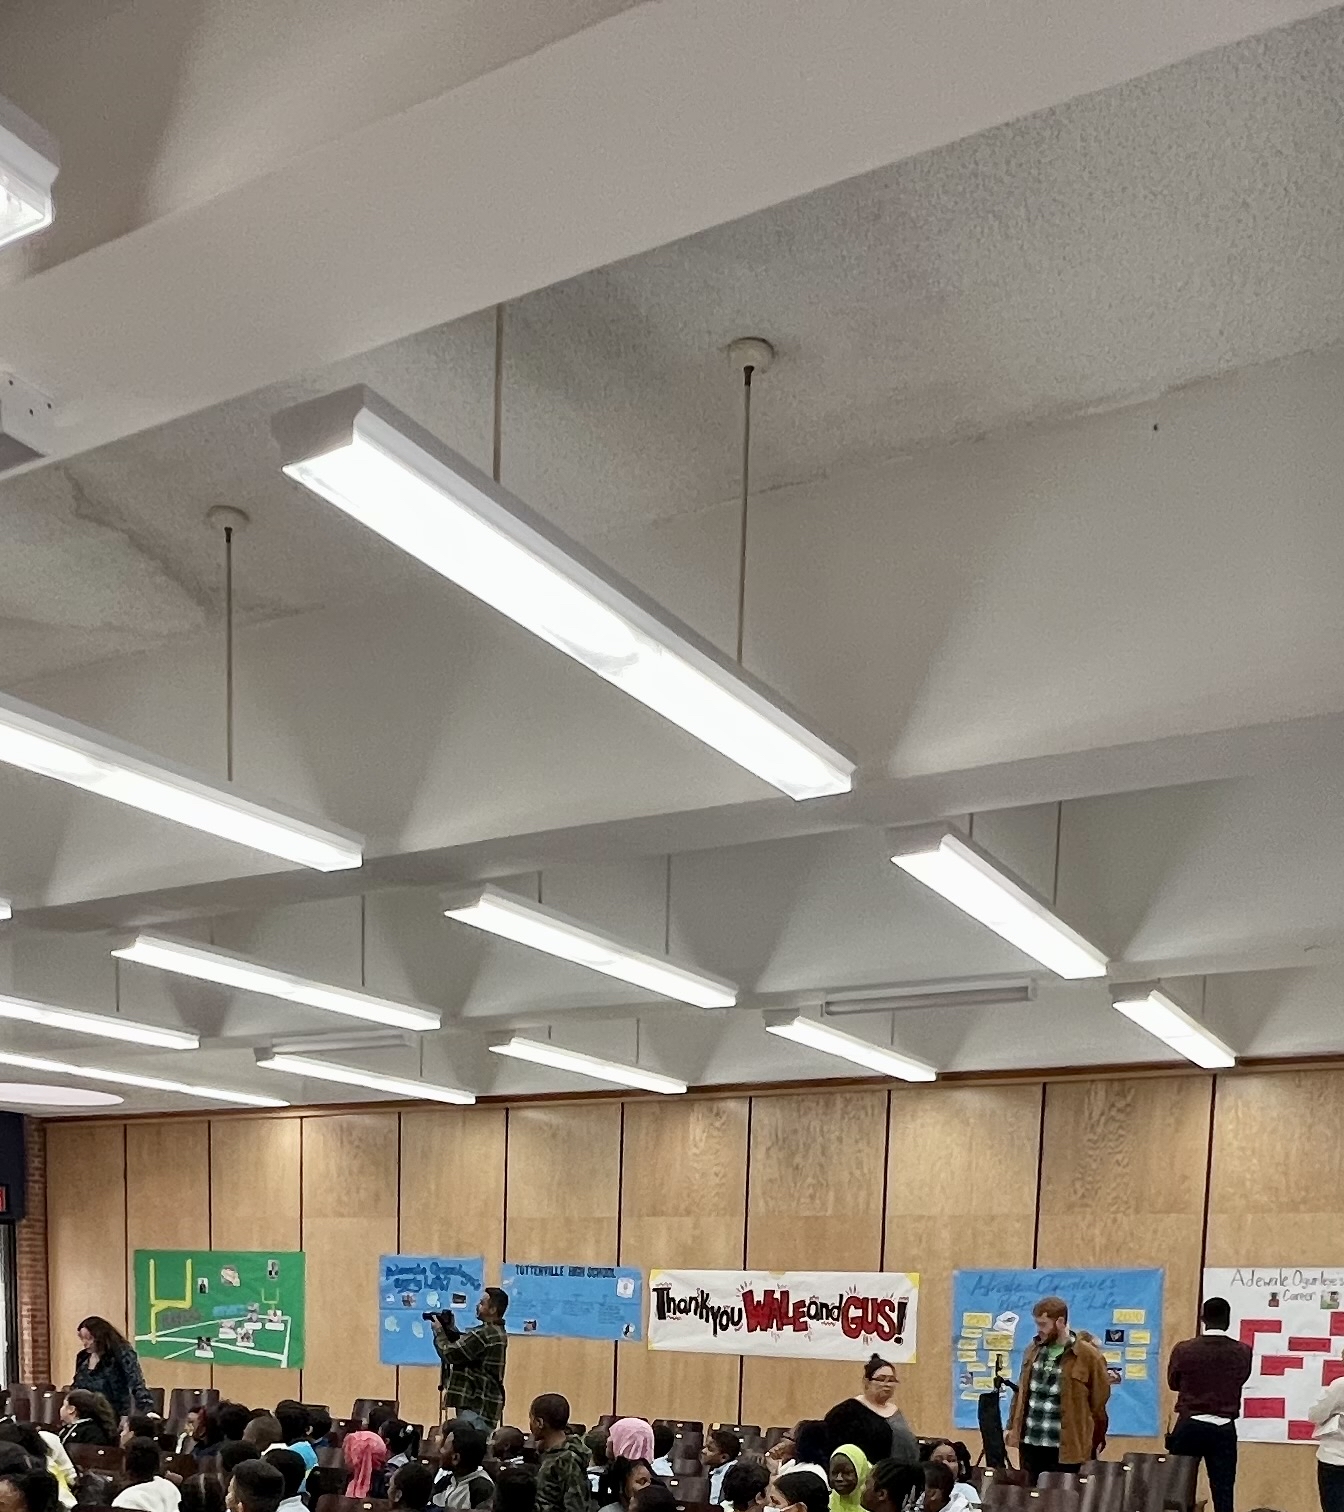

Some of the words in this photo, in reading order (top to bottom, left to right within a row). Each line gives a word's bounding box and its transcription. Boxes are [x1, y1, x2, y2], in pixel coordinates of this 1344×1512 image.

[652, 1287, 711, 1323] Thank
[741, 1289, 808, 1333] WALE
[807, 1294, 843, 1322] and
[841, 1295, 908, 1345] GUS!
